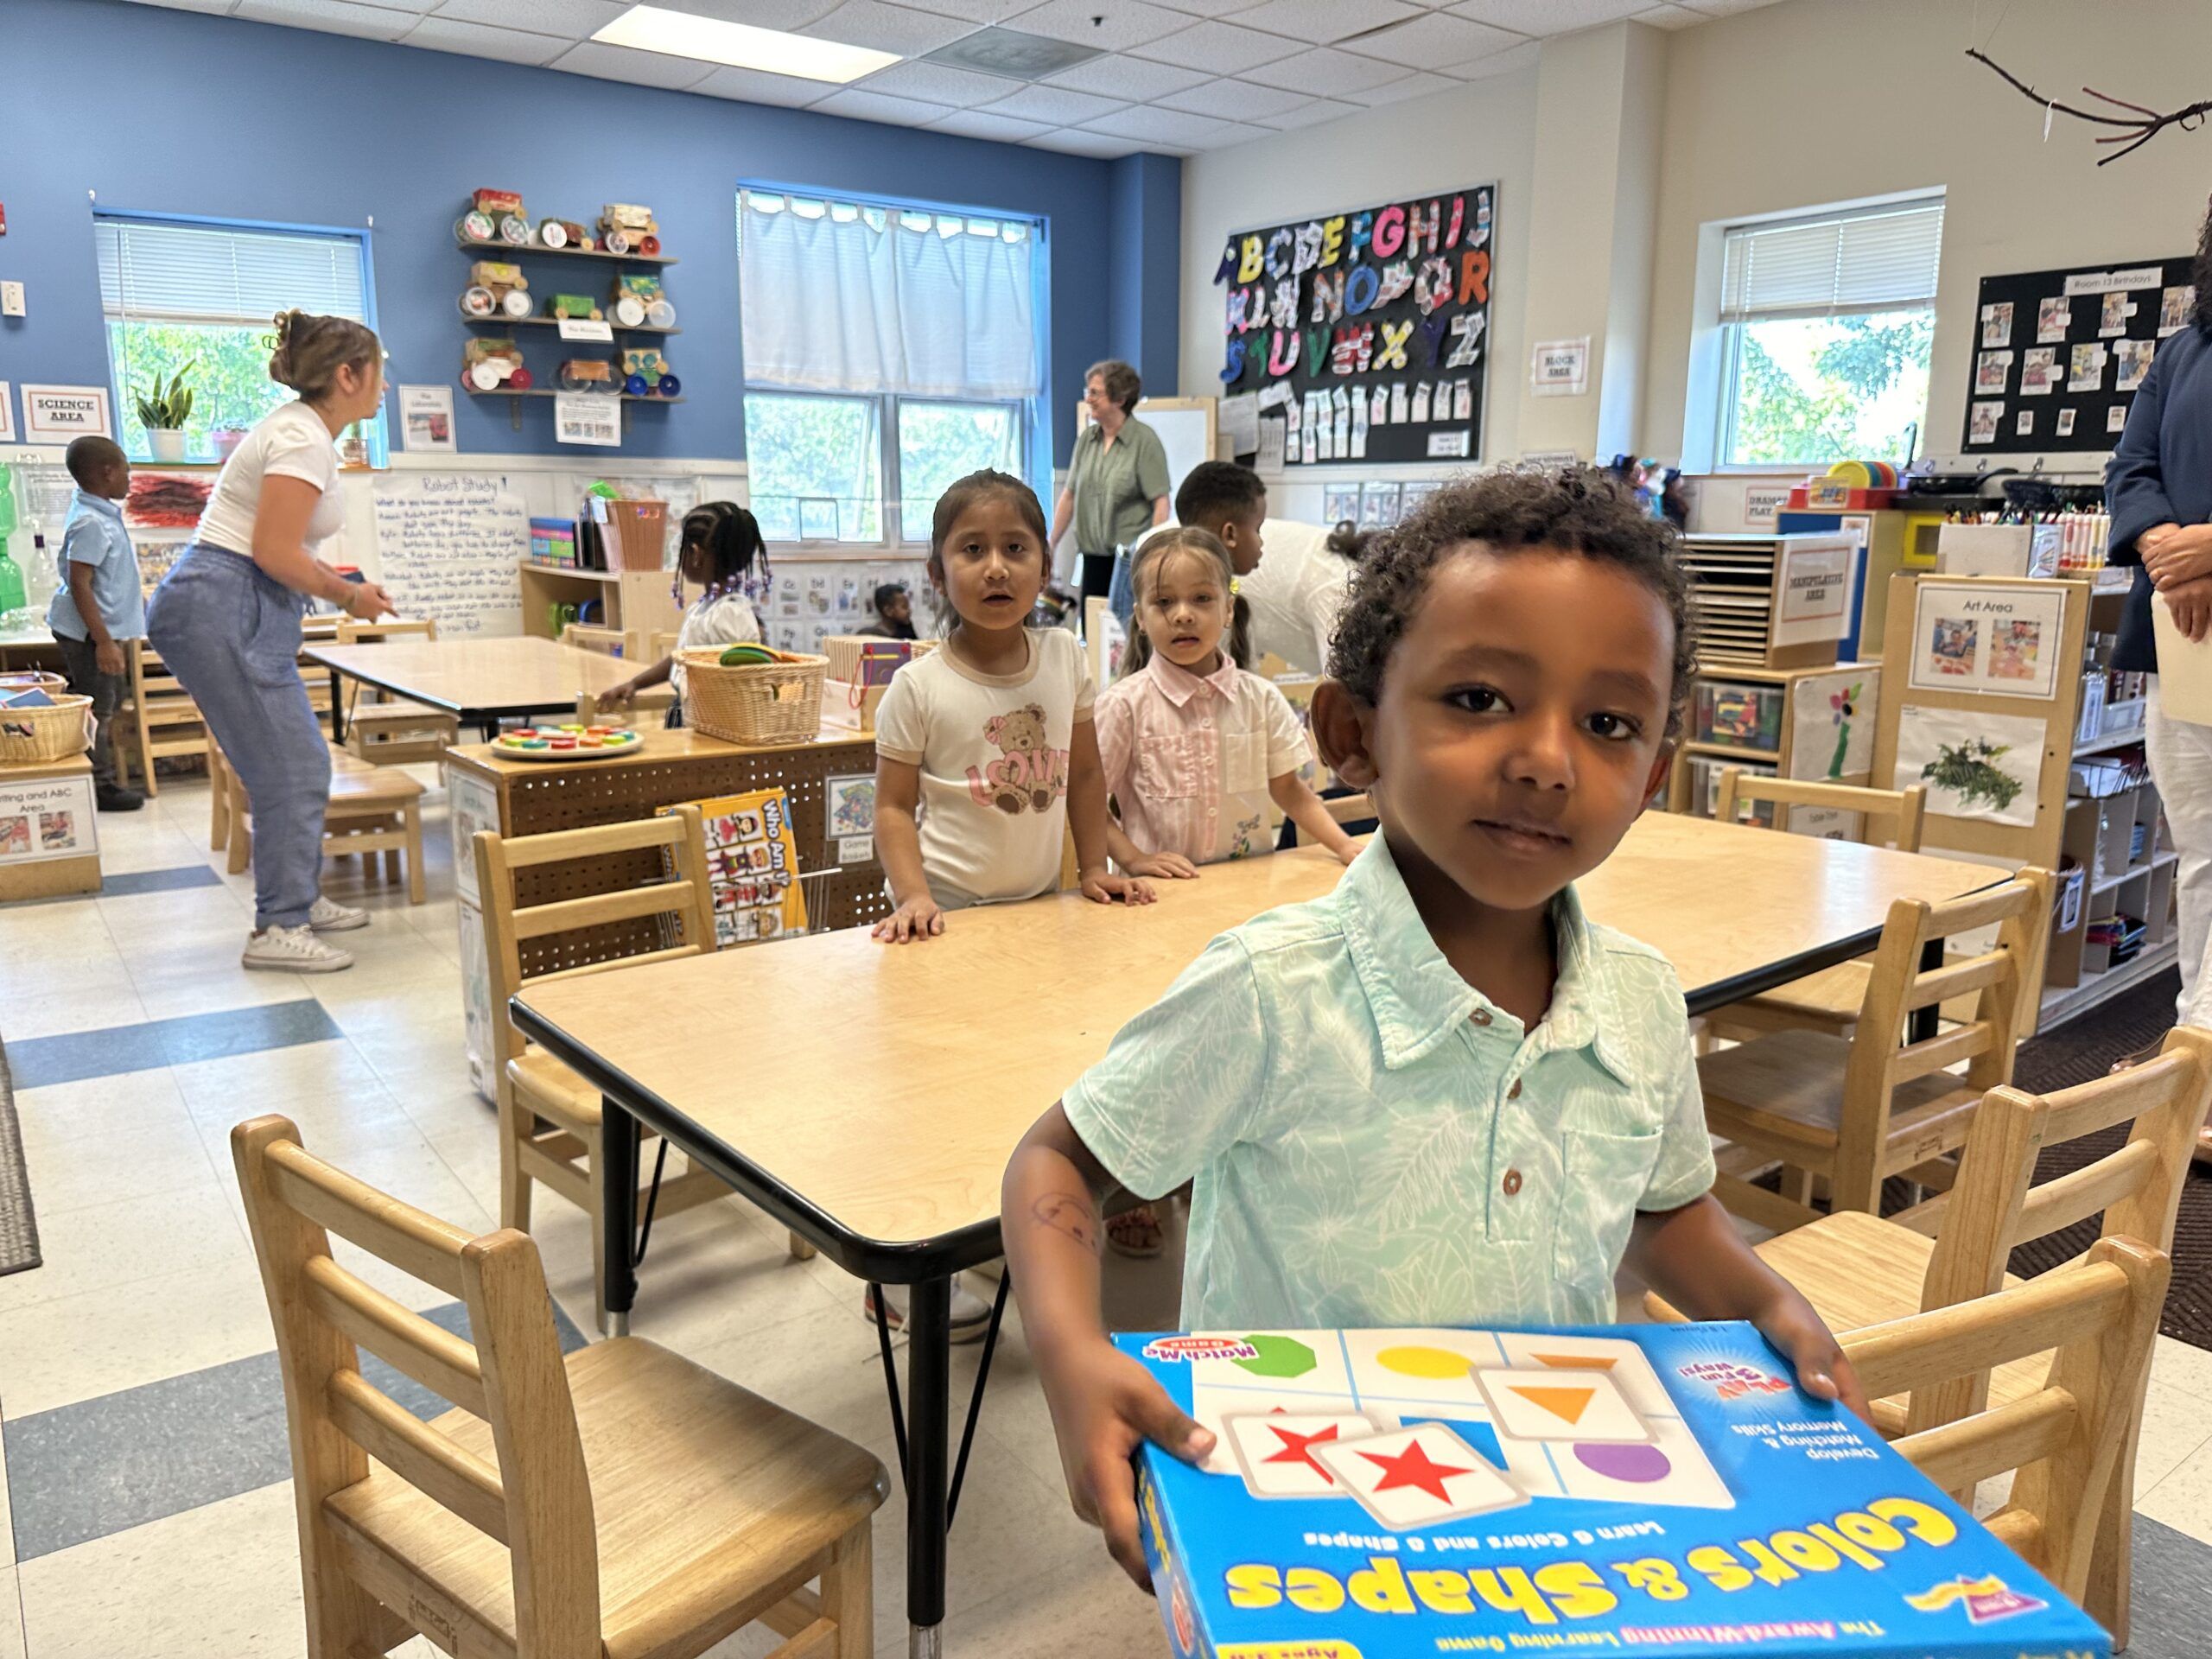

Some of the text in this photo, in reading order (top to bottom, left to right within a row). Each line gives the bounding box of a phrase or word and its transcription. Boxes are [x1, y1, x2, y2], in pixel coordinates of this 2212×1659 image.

[1371, 205, 1407, 258] G
[1344, 264, 1379, 315] O
[1458, 251, 1491, 305] R
[2074, 278, 2101, 289] Room
[2113, 274, 2152, 287] Birthdays
[1372, 319, 1414, 371] X
[1545, 355, 1575, 367] BLOCK
[38, 398, 94, 410] SCIENCE
[50, 411, 84, 423] AREA
[423, 477, 458, 492] Robot
[1963, 601, 2013, 613] Art Area
[27, 791, 48, 800] and
[50, 787, 72, 798] ABC
[20, 804, 45, 813] Area
[762, 798, 780, 840] Who
[768, 840, 786, 870] Am
[1145, 1345, 1257, 1361] Match Me
[1678, 1361, 1735, 1376] Ways!
[1700, 1367, 1760, 1382] 3 Fun
[1716, 1377, 1791, 1402] PLAY
[1730, 1419, 1849, 1437] Memory Skills
[1761, 1433, 1864, 1451] Matching &
[1806, 1446, 1880, 1463] Develop
[1600, 1519, 1666, 1540] Learn
[1302, 1530, 1400, 1553] Shapes
[1432, 1534, 1480, 1553] and
[1485, 1530, 1567, 1552] Colors
[1223, 1496, 1959, 1627] Colors & Shapes
[1434, 1618, 1885, 1656] The Award-Winning Learning Game
